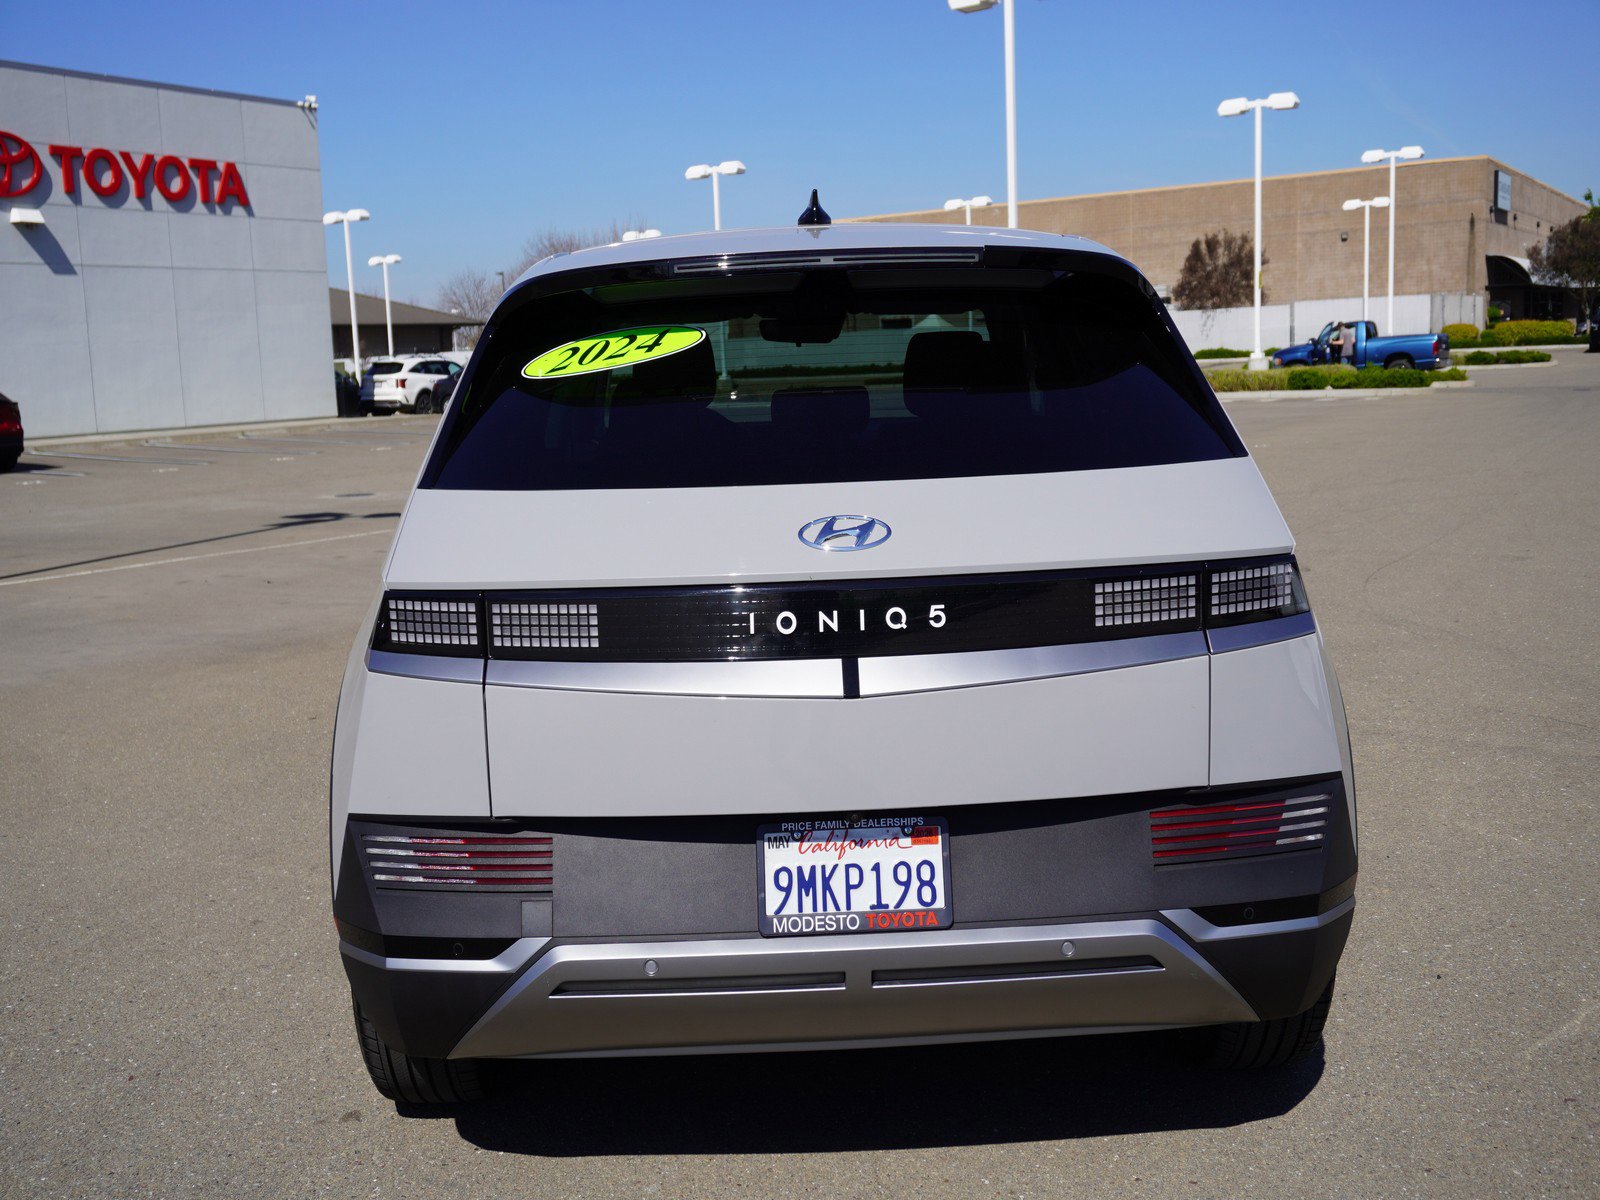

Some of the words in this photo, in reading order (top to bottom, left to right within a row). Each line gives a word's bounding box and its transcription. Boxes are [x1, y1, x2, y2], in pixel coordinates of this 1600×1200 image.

[48, 144, 250, 207] TOYOTA
[544, 327, 672, 375] 2024
[749, 606, 908, 635] IONIQ
[928, 604, 947, 629] 5
[781, 821, 812, 832] PRICE
[815, 819, 850, 830] FAMILY
[853, 816, 924, 828] DEALERSHIPS
[767, 835, 791, 850] MAY
[798, 829, 913, 861] California
[773, 859, 938, 916] 9MKP198
[773, 914, 860, 934] MODESTO
[866, 911, 939, 929] TOYOTA
